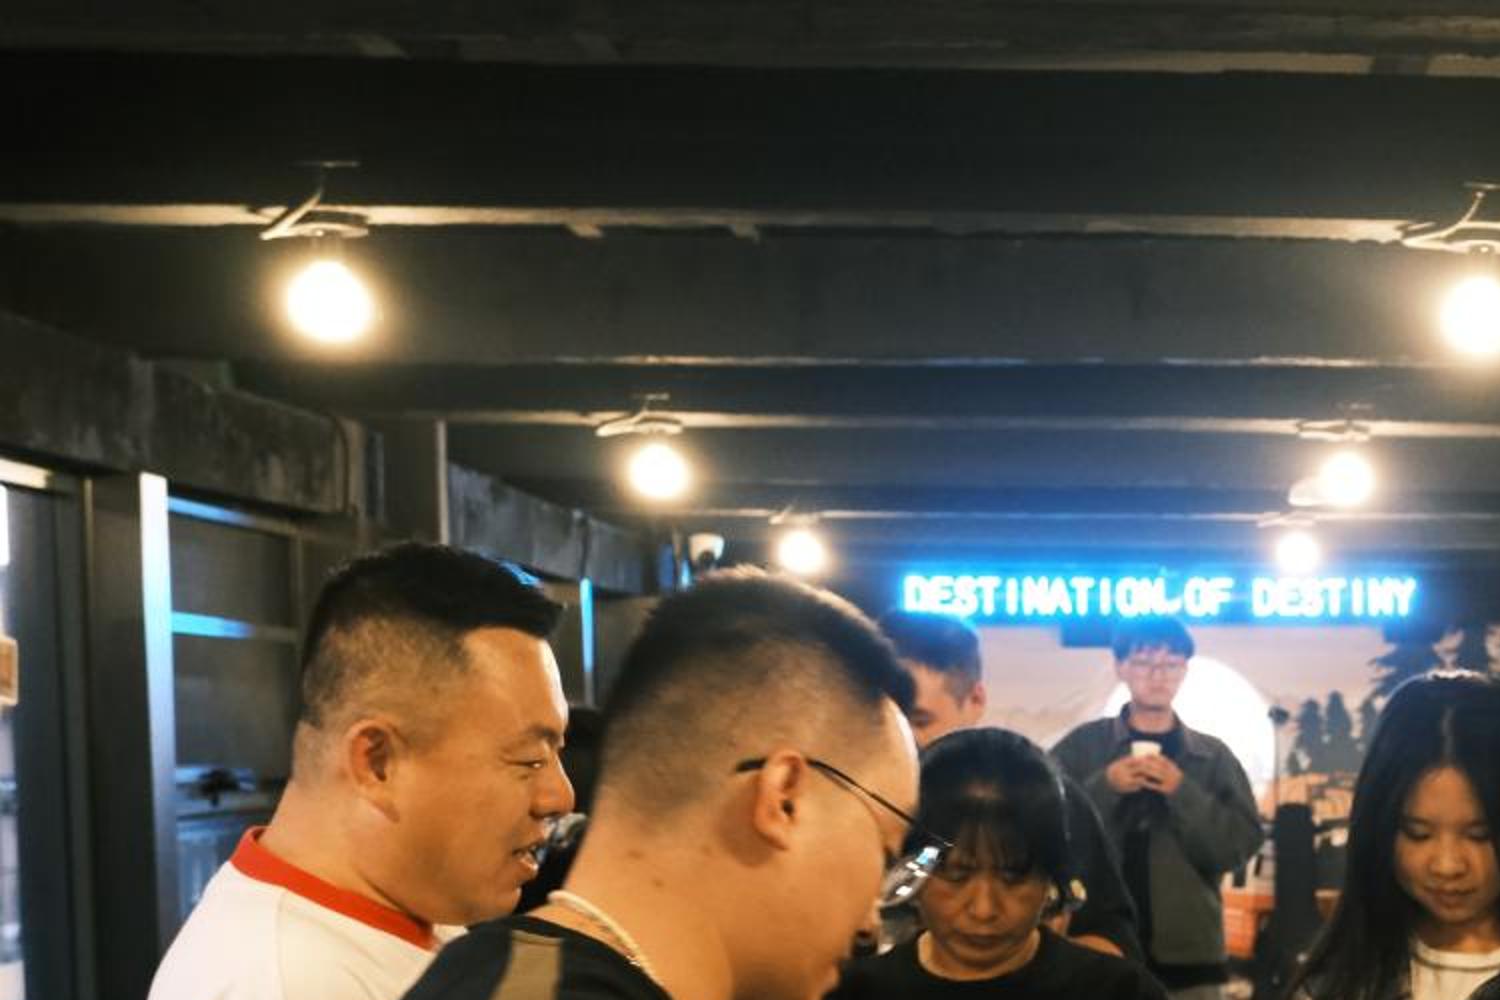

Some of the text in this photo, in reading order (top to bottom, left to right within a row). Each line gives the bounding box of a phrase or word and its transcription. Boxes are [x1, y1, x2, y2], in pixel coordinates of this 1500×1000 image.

[903, 575, 1417, 617] DESTINATION OF DESTINY
